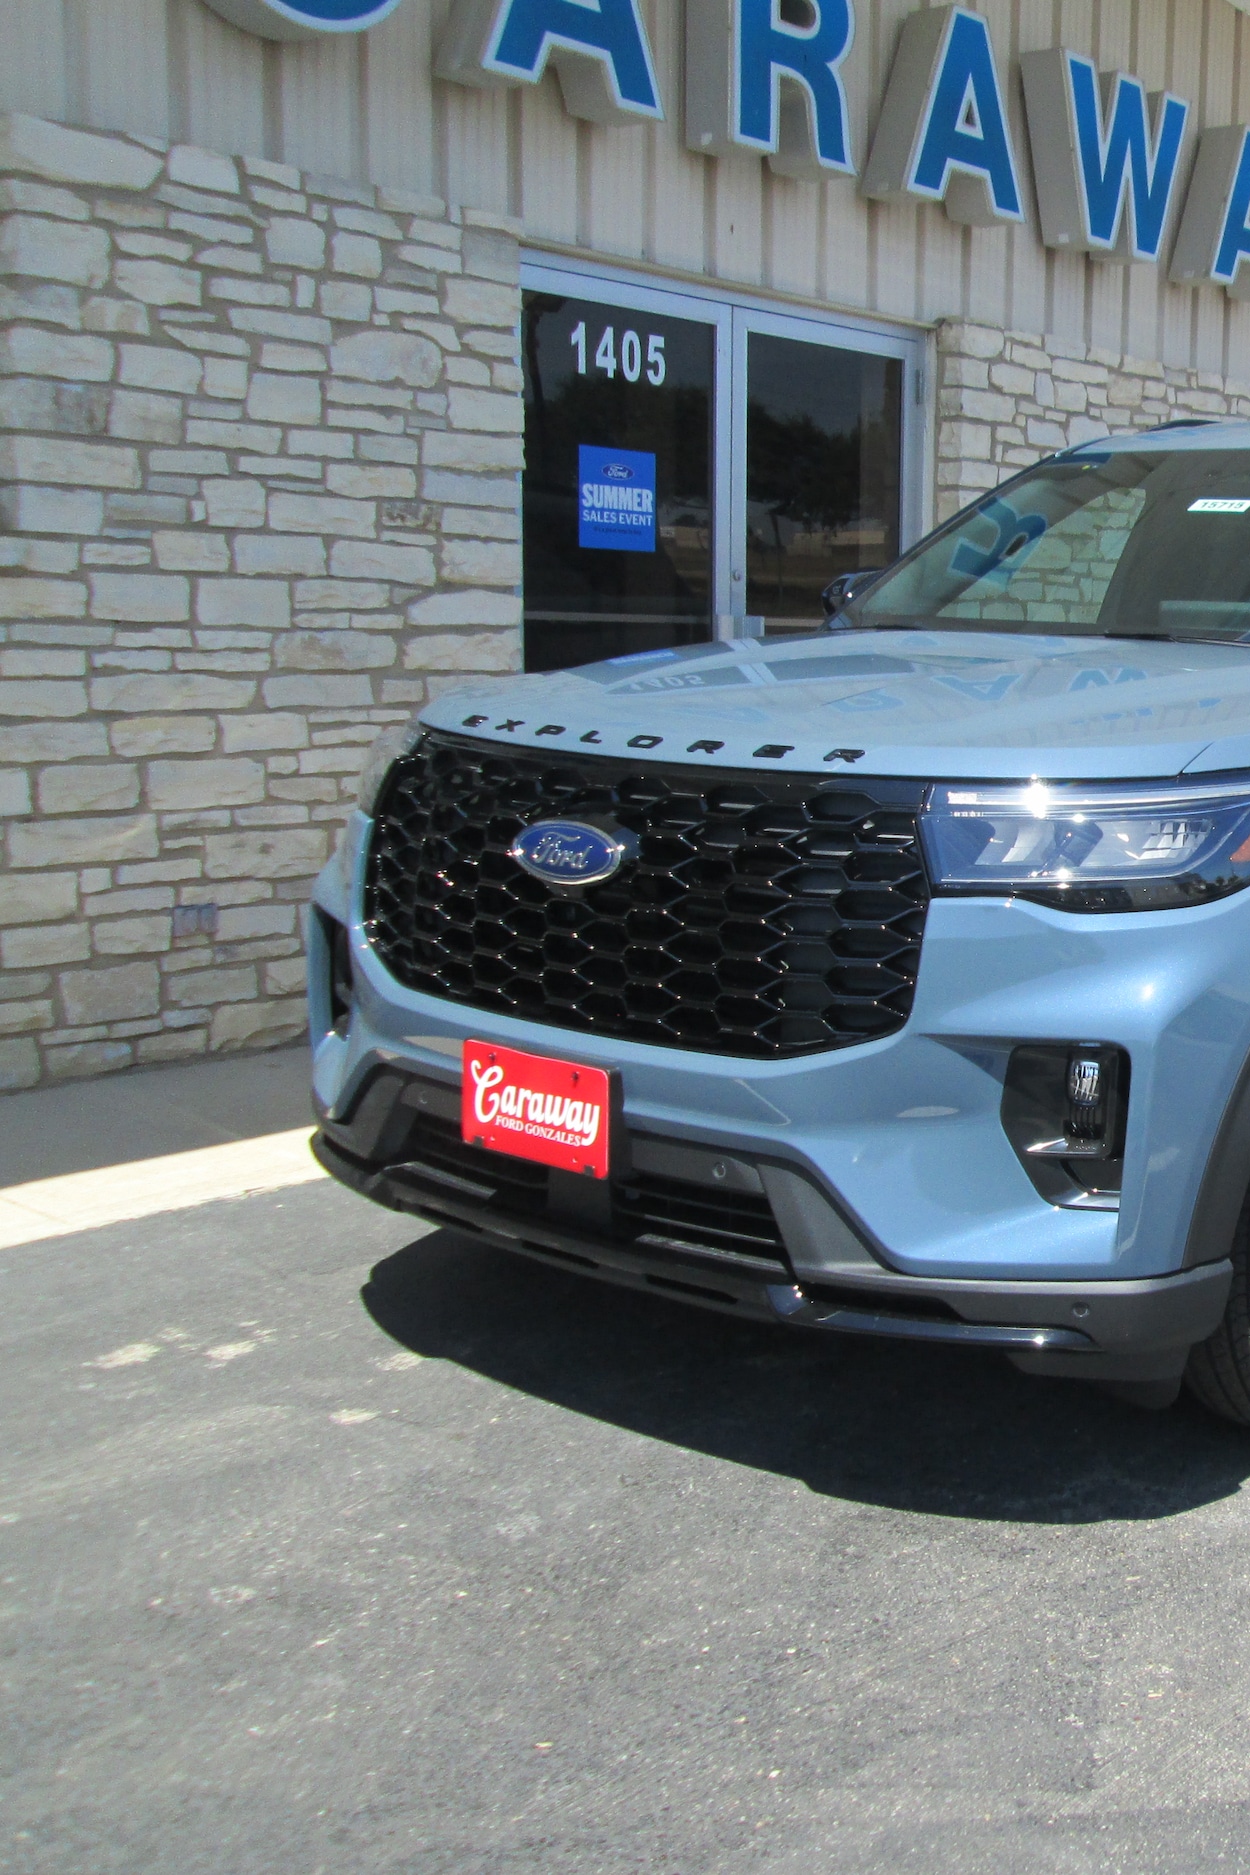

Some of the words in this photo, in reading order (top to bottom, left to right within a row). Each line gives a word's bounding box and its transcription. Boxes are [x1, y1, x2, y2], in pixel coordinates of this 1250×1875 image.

[571, 321, 666, 386] 1405
[607, 464, 629, 478] Ford
[582, 483, 653, 513] SUMMER
[583, 510, 617, 524] SALES
[619, 513, 653, 526] EVENT
[462, 714, 866, 764] EXPLORER
[533, 831, 593, 870] Ford
[471, 1059, 600, 1147] Caraway
[495, 1115, 524, 1132] FORD
[525, 1123, 583, 1147] GONZALES
